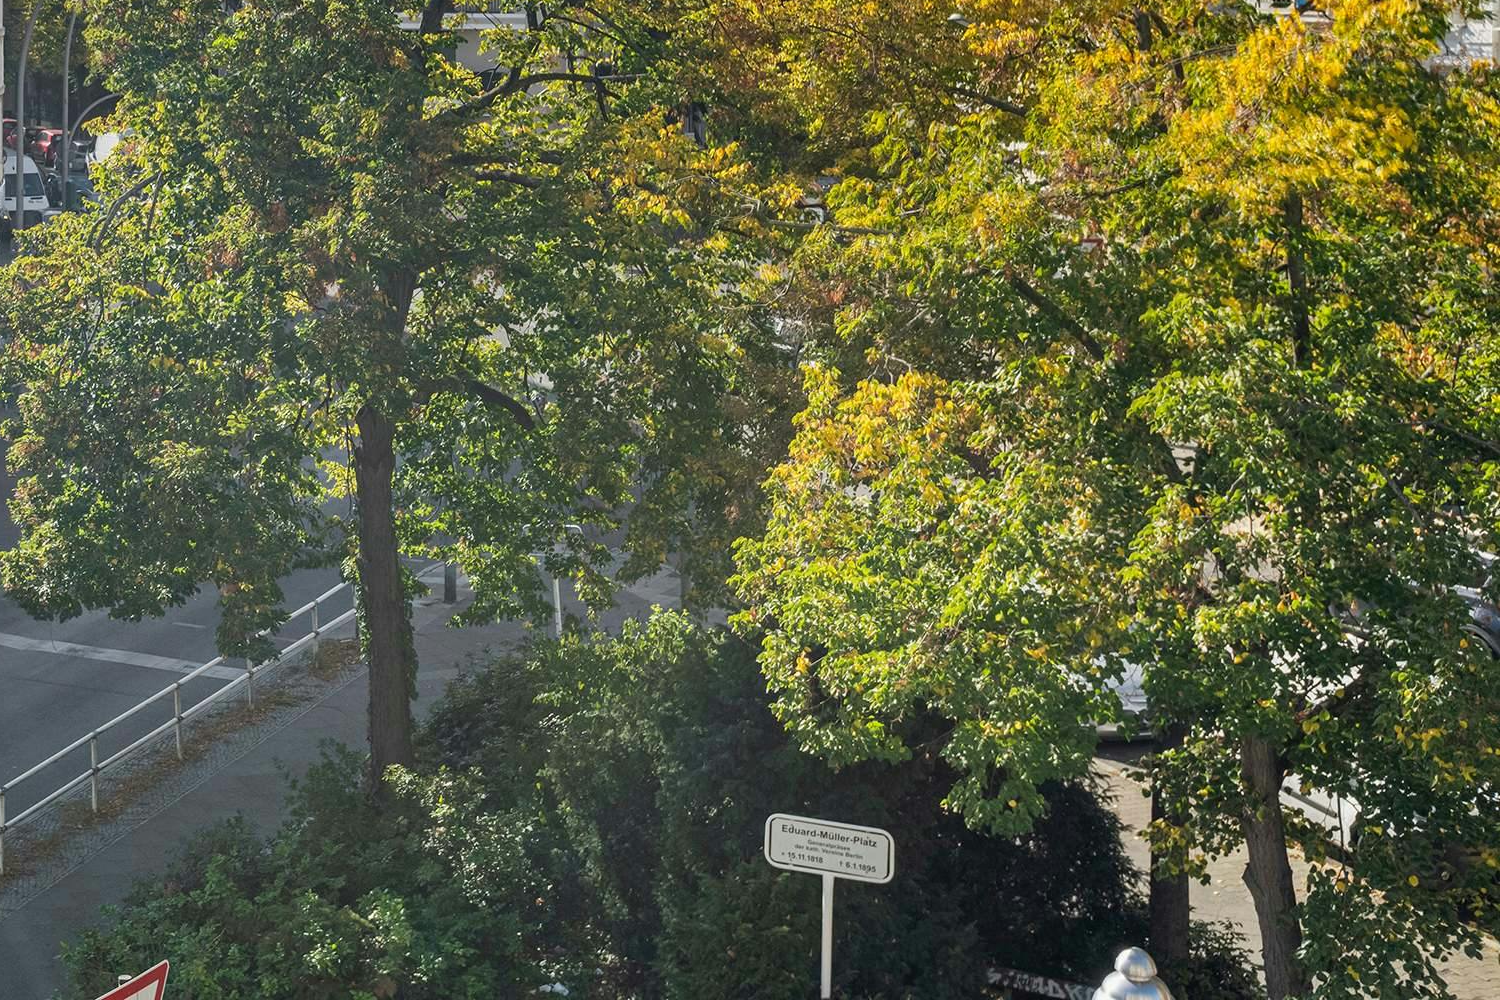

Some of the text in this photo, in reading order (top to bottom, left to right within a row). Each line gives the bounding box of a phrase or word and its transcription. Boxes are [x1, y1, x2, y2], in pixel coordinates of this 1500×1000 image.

[781, 824, 877, 848] Eduard-Müller-Platz
[787, 851, 824, 864] 15.11.1818
[845, 862, 876, 873] 6.1.1895
